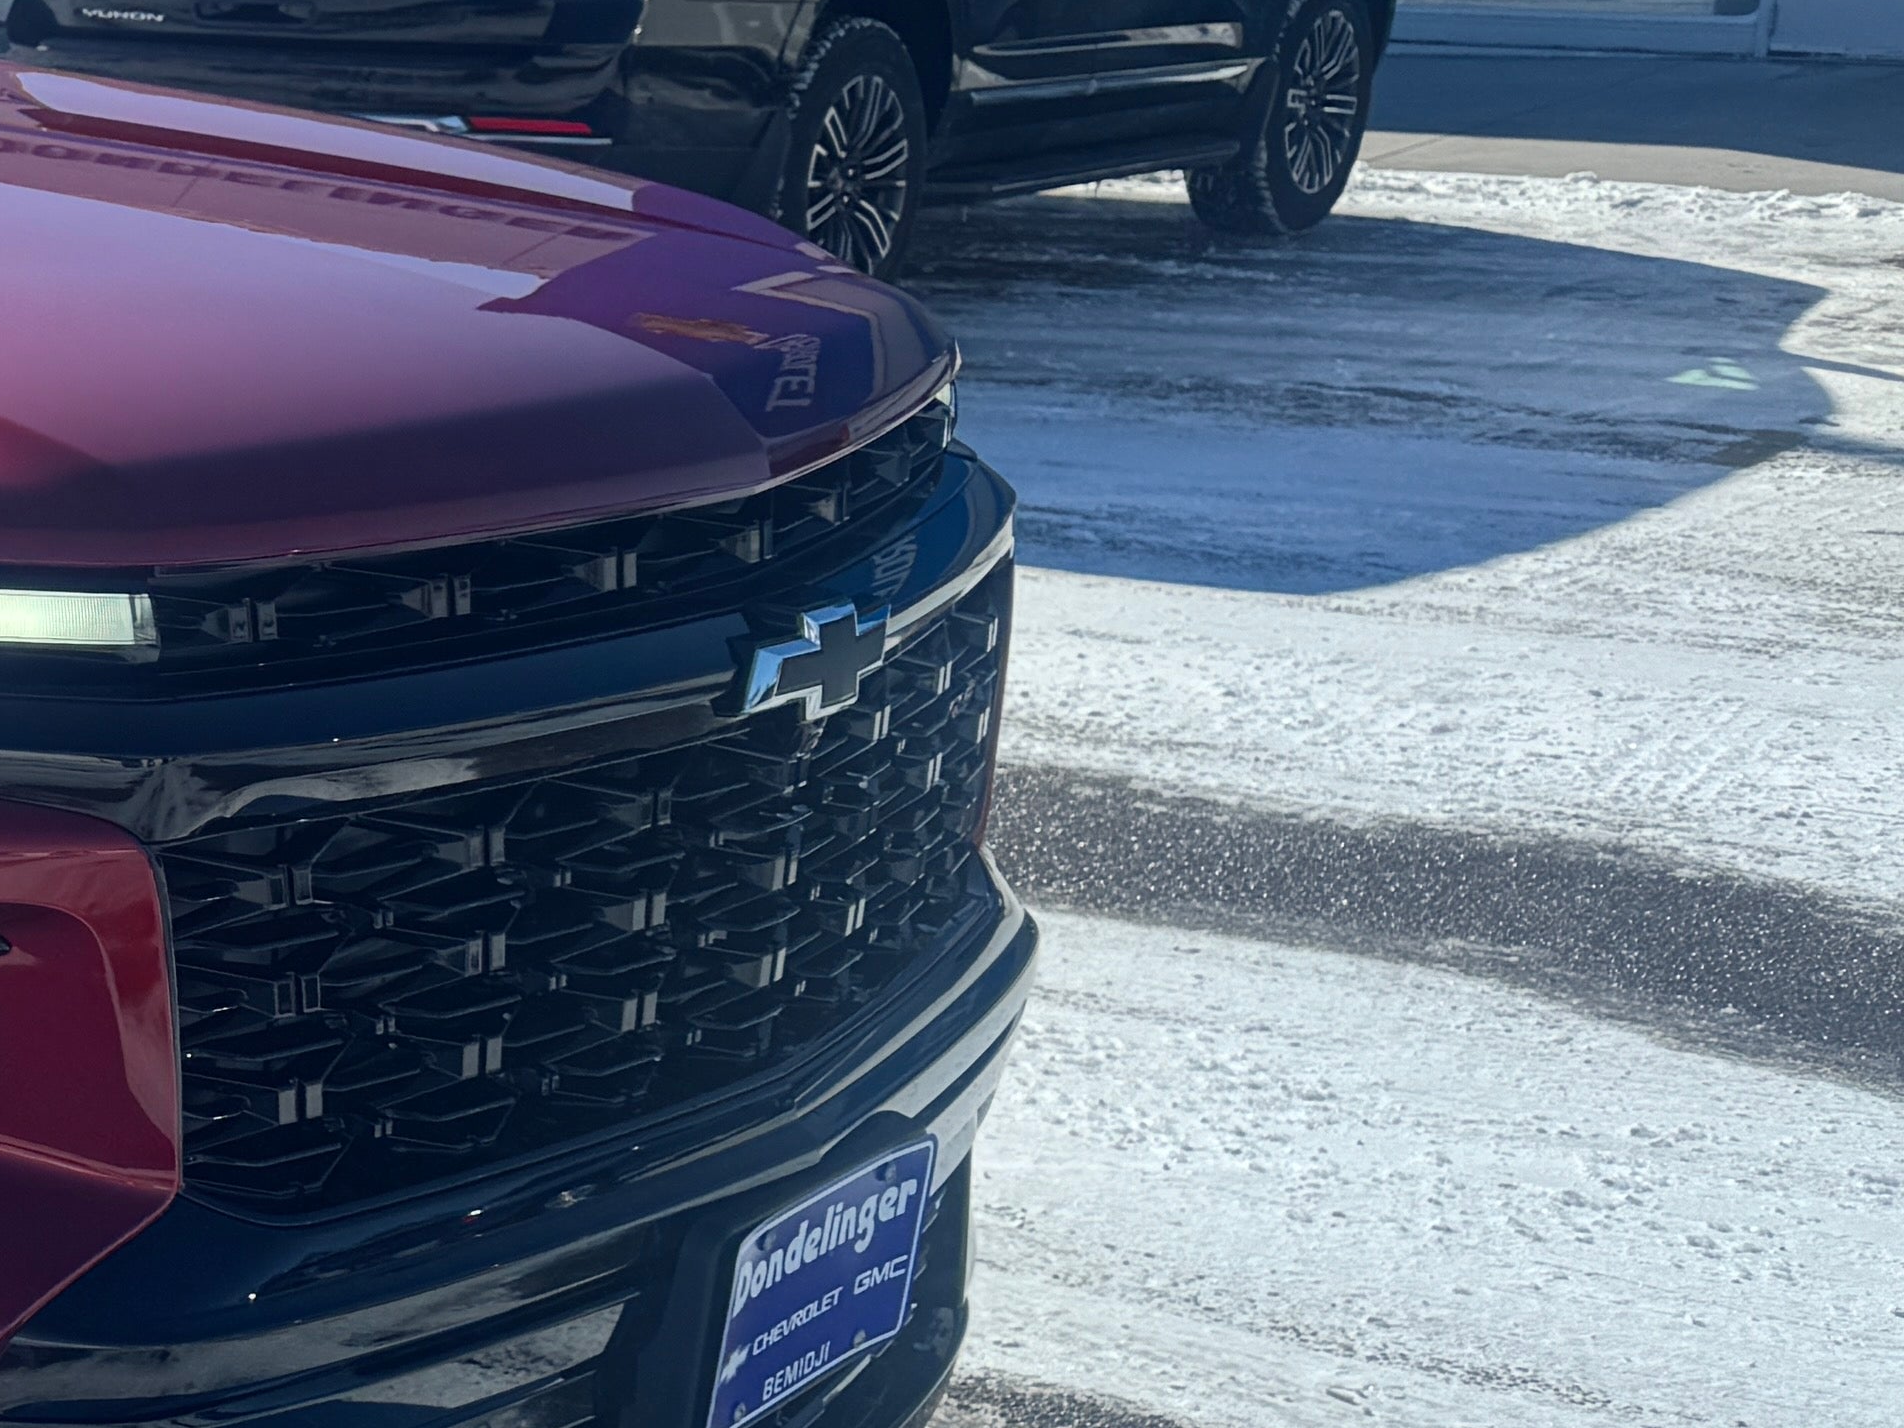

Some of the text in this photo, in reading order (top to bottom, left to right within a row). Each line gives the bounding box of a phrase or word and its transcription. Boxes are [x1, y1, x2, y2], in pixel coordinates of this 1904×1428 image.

[732, 1178, 918, 1318] Dondelinger
[752, 1254, 909, 1356] CHEVROLET GMC
[762, 1340, 832, 1401] BEMIDJI
